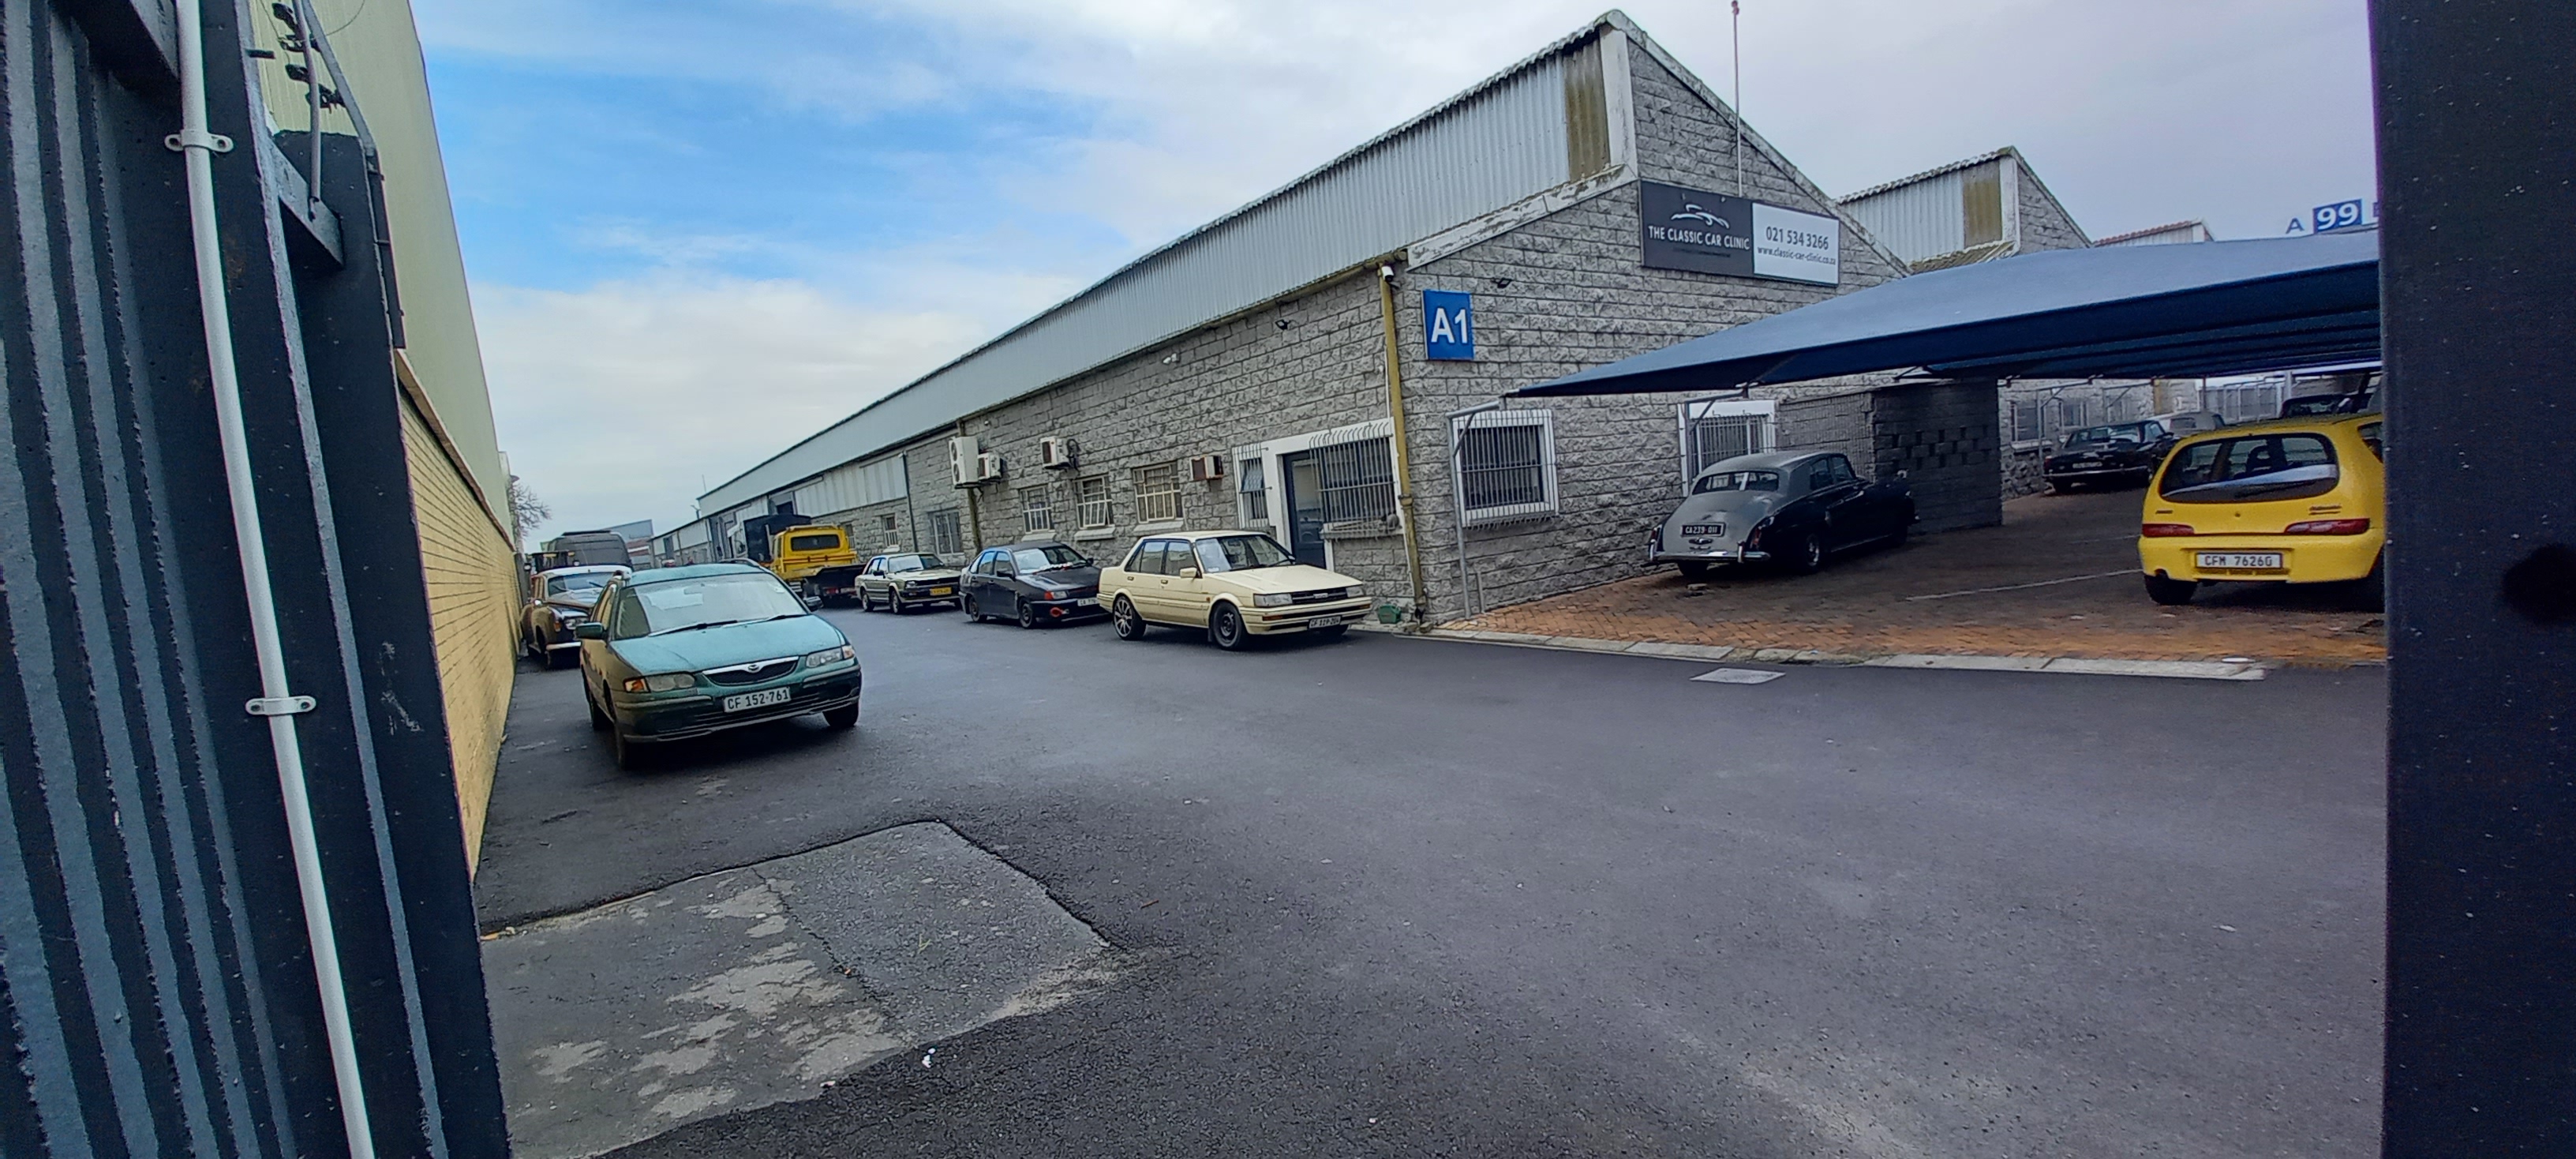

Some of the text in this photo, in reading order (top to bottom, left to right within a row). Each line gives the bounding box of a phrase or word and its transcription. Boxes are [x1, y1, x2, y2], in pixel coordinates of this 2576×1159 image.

[2286, 217, 2305, 234] A
[2316, 203, 2359, 231] 99
[1648, 225, 1750, 250] THE CLASSIC CAR CLINIC
[1765, 226, 1829, 250] 021 534 3266
[1431, 307, 1468, 344] A1
[2204, 555, 2226, 566] CFM
[727, 688, 789, 710] CF 152-761
